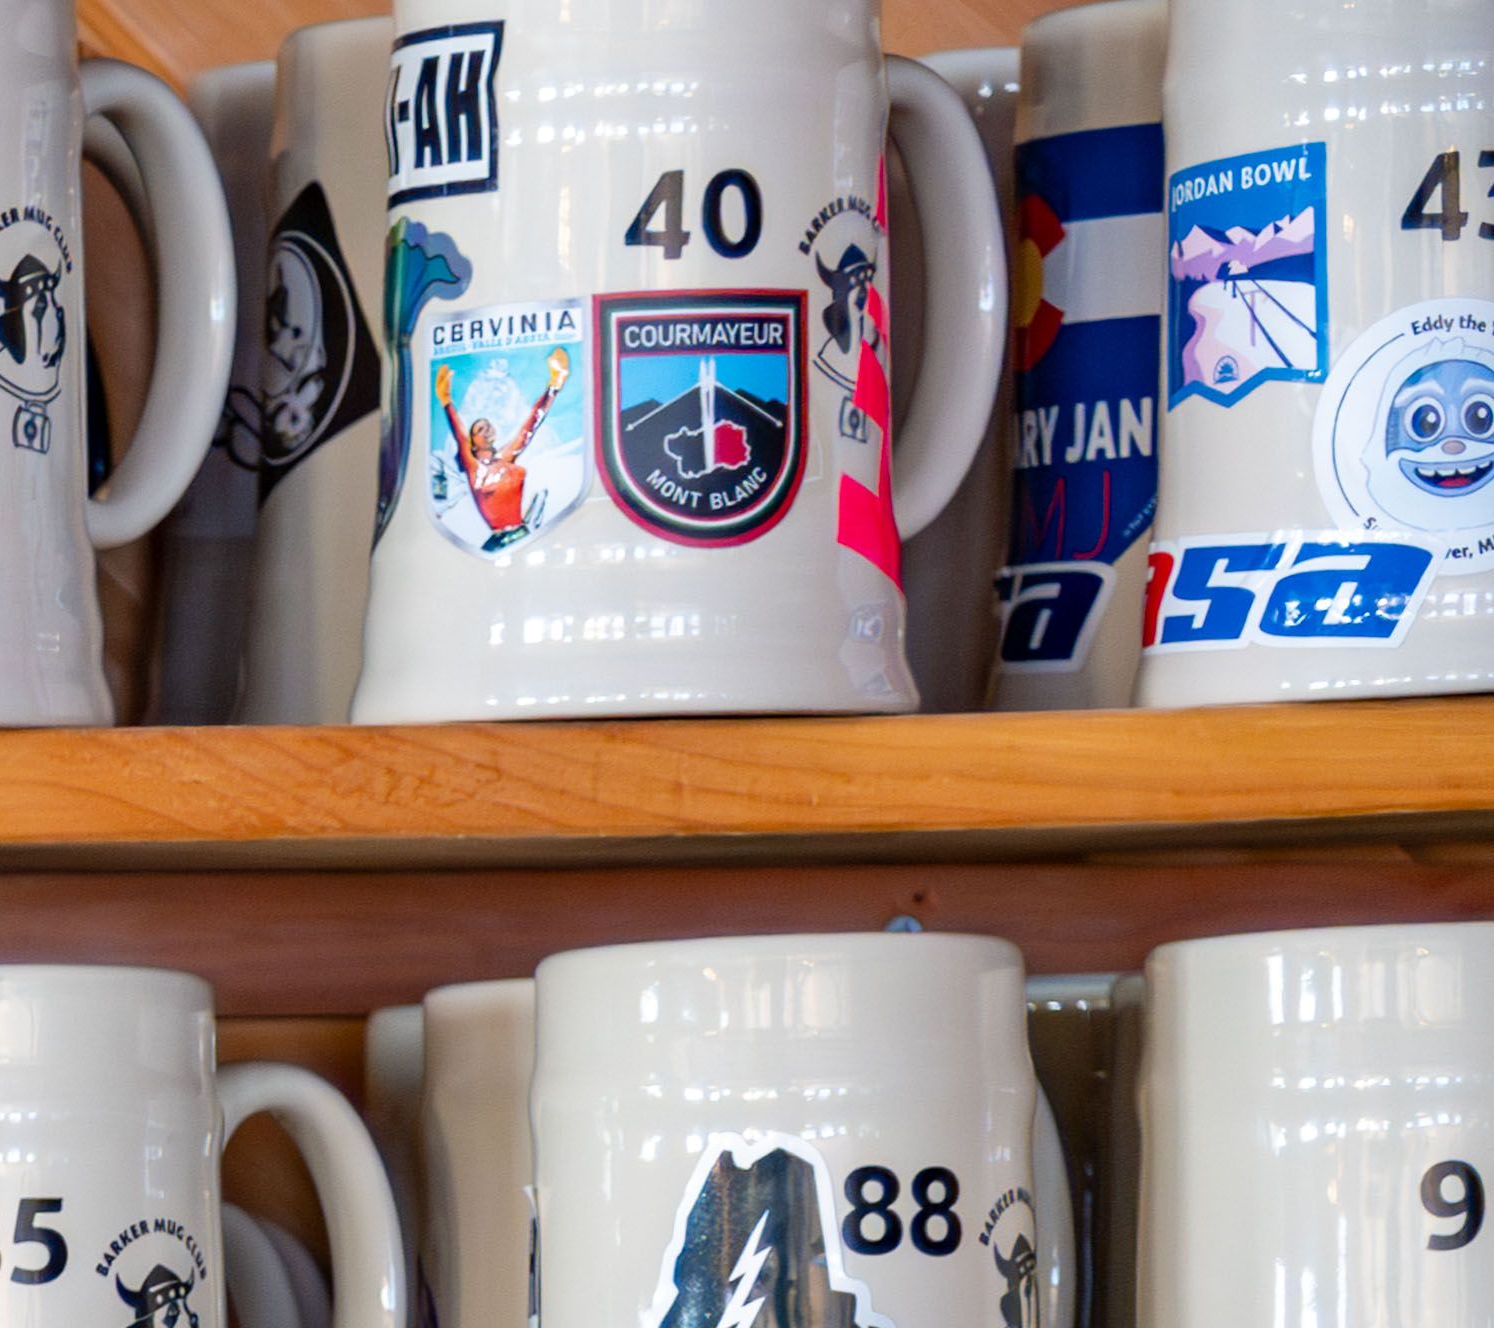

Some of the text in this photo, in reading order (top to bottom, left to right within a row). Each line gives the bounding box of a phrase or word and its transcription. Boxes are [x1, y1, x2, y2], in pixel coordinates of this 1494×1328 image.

[1171, 156, 1311, 212] JORDAN BOWL
[624, 168, 763, 260] 40
[433, 309, 576, 346] CERVINIA
[624, 320, 783, 349] COURMAYEUR
[1411, 313, 1486, 336] Eddy the
[646, 466, 768, 510] MONT BLANC
[842, 1166, 963, 1256] 88
